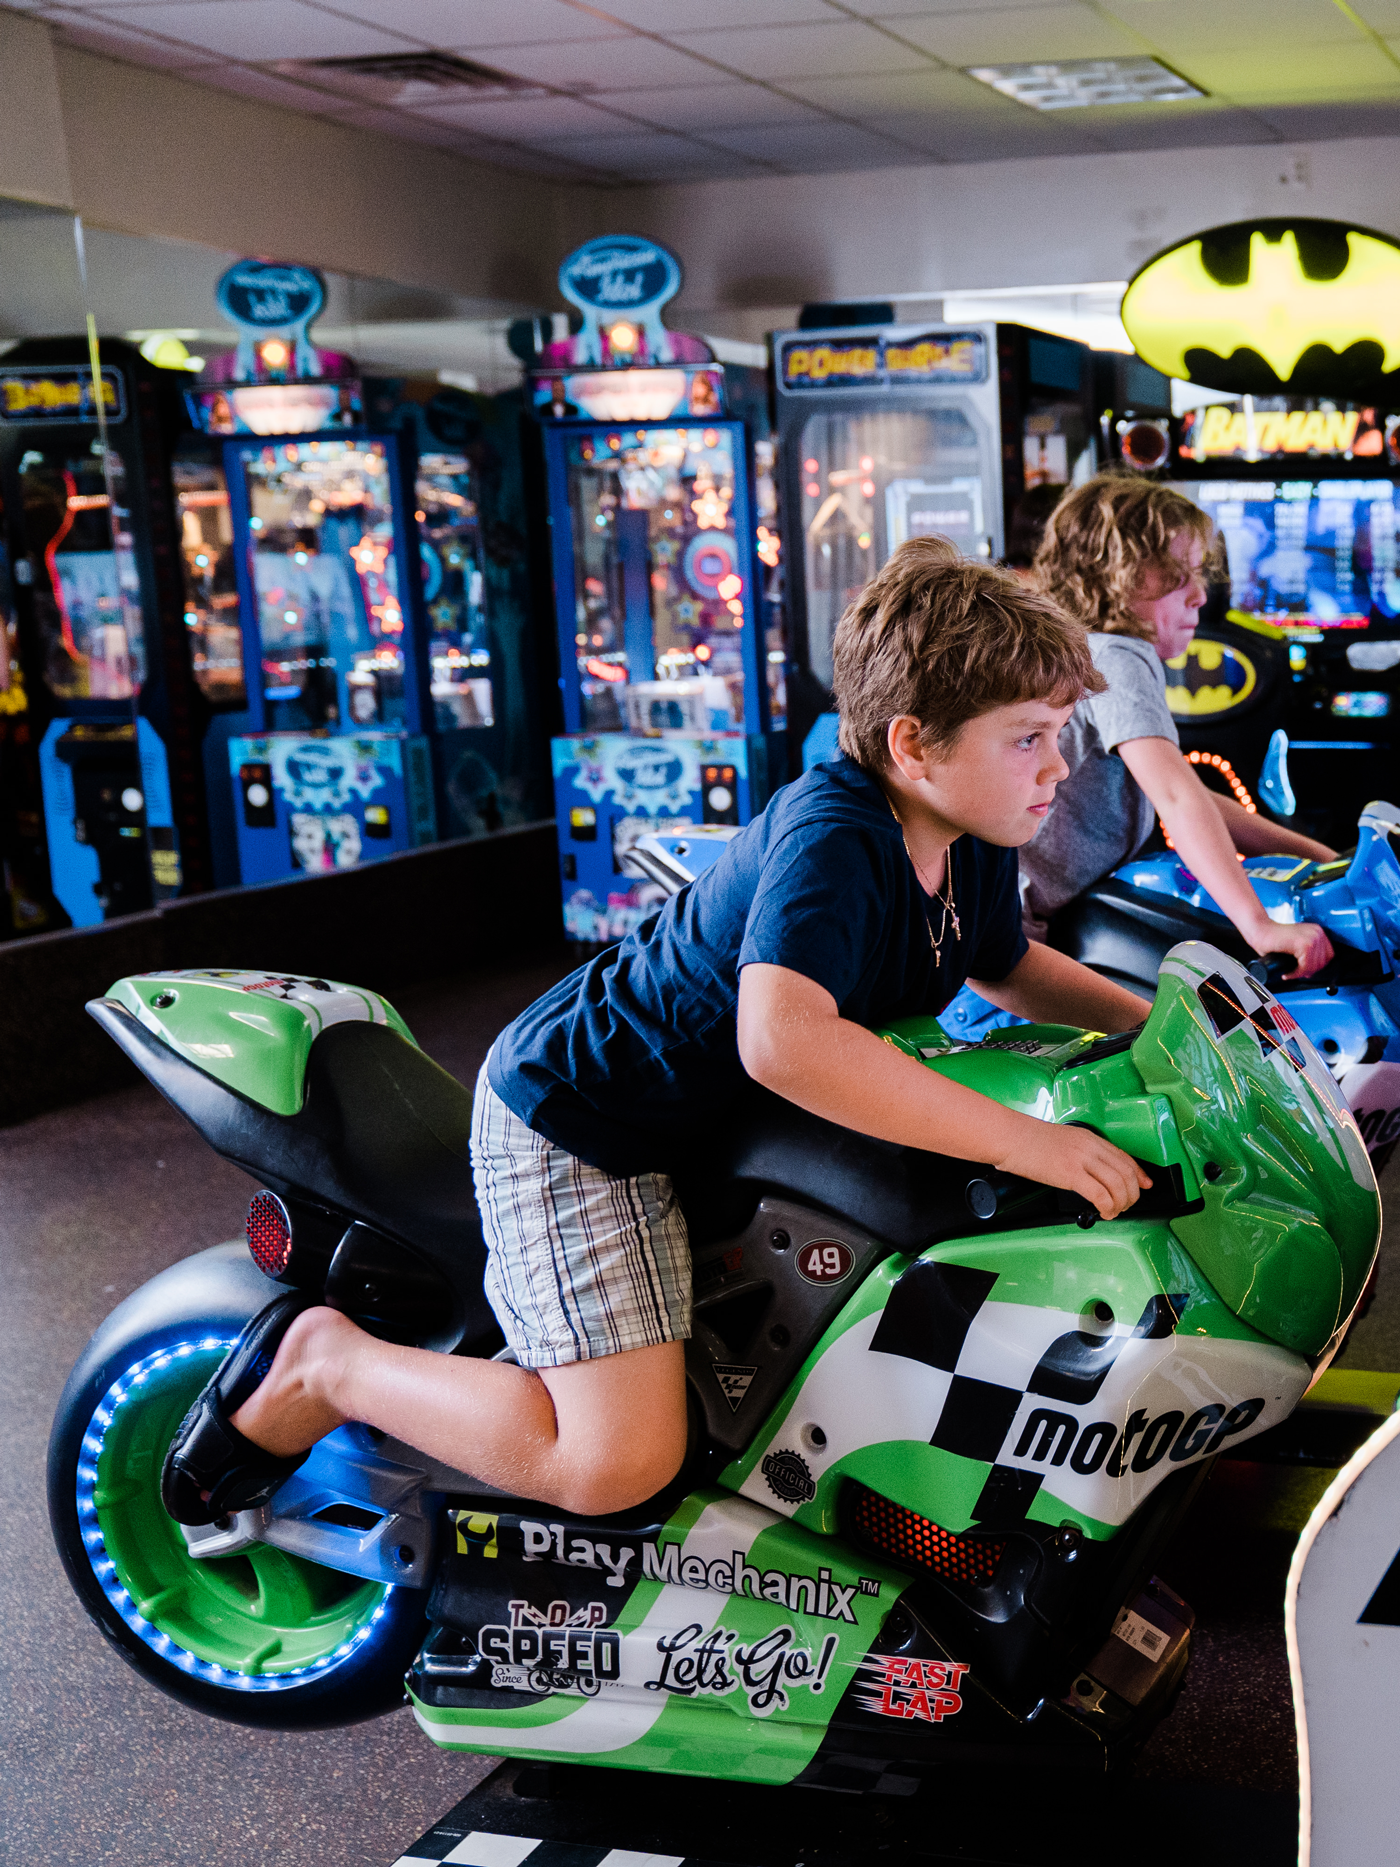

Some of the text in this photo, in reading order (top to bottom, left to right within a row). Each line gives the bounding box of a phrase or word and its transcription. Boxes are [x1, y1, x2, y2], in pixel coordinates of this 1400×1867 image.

[1203, 405, 1359, 450] BATMAN
[807, 1246, 841, 1276] 49
[1013, 1397, 1266, 1478] motoGP
[767, 1461, 809, 1493] OFFICIAL
[520, 1520, 636, 1588] Play
[508, 1600, 607, 1630] TOP
[478, 1625, 623, 1681] SPEED
[643, 1622, 837, 1709] Let's Go!
[492, 1666, 524, 1685] Since
[878, 1656, 971, 1692] FAST
[877, 1685, 963, 1723] LAP
